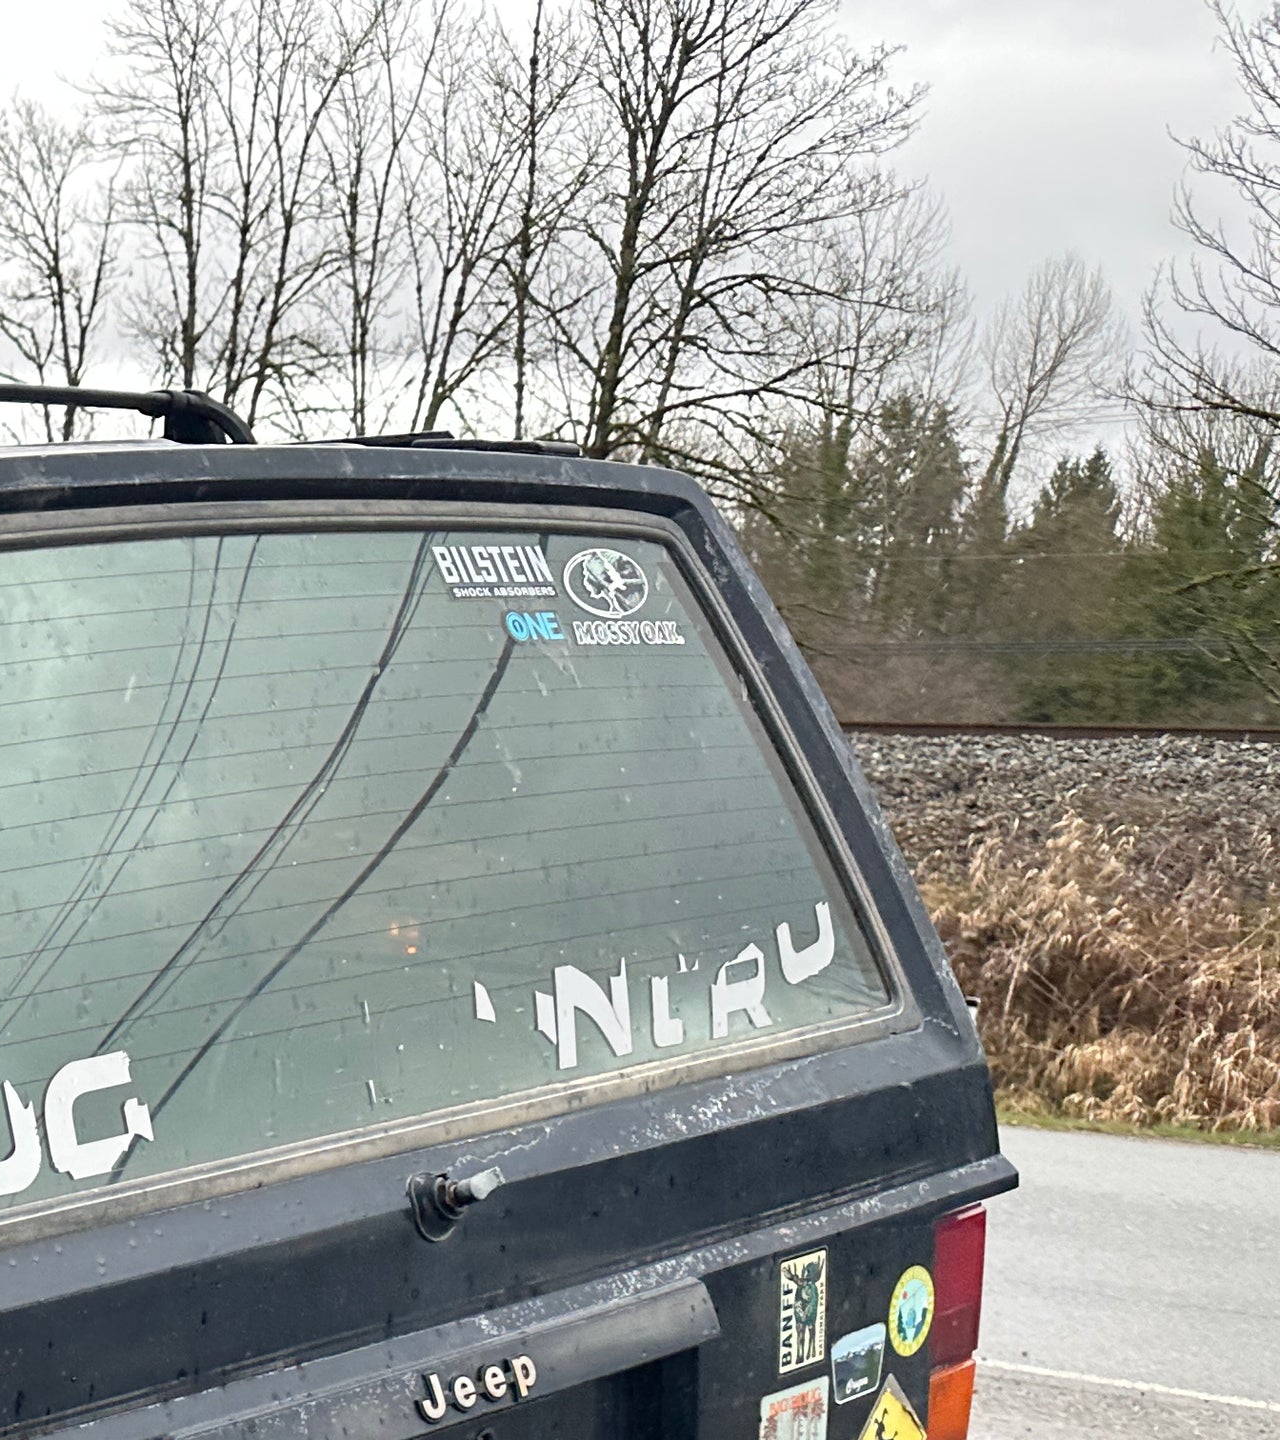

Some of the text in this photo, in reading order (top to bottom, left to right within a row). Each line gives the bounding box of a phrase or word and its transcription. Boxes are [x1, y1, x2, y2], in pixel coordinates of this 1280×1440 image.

[432, 545, 554, 584] BILSTEIN
[452, 586, 556, 598] SHOCK ABSORBERS
[505, 611, 566, 641] ONE
[572, 620, 640, 645] MOSSY
[781, 1282, 793, 1367] BANFF
[420, 1354, 537, 1422] Jeep
